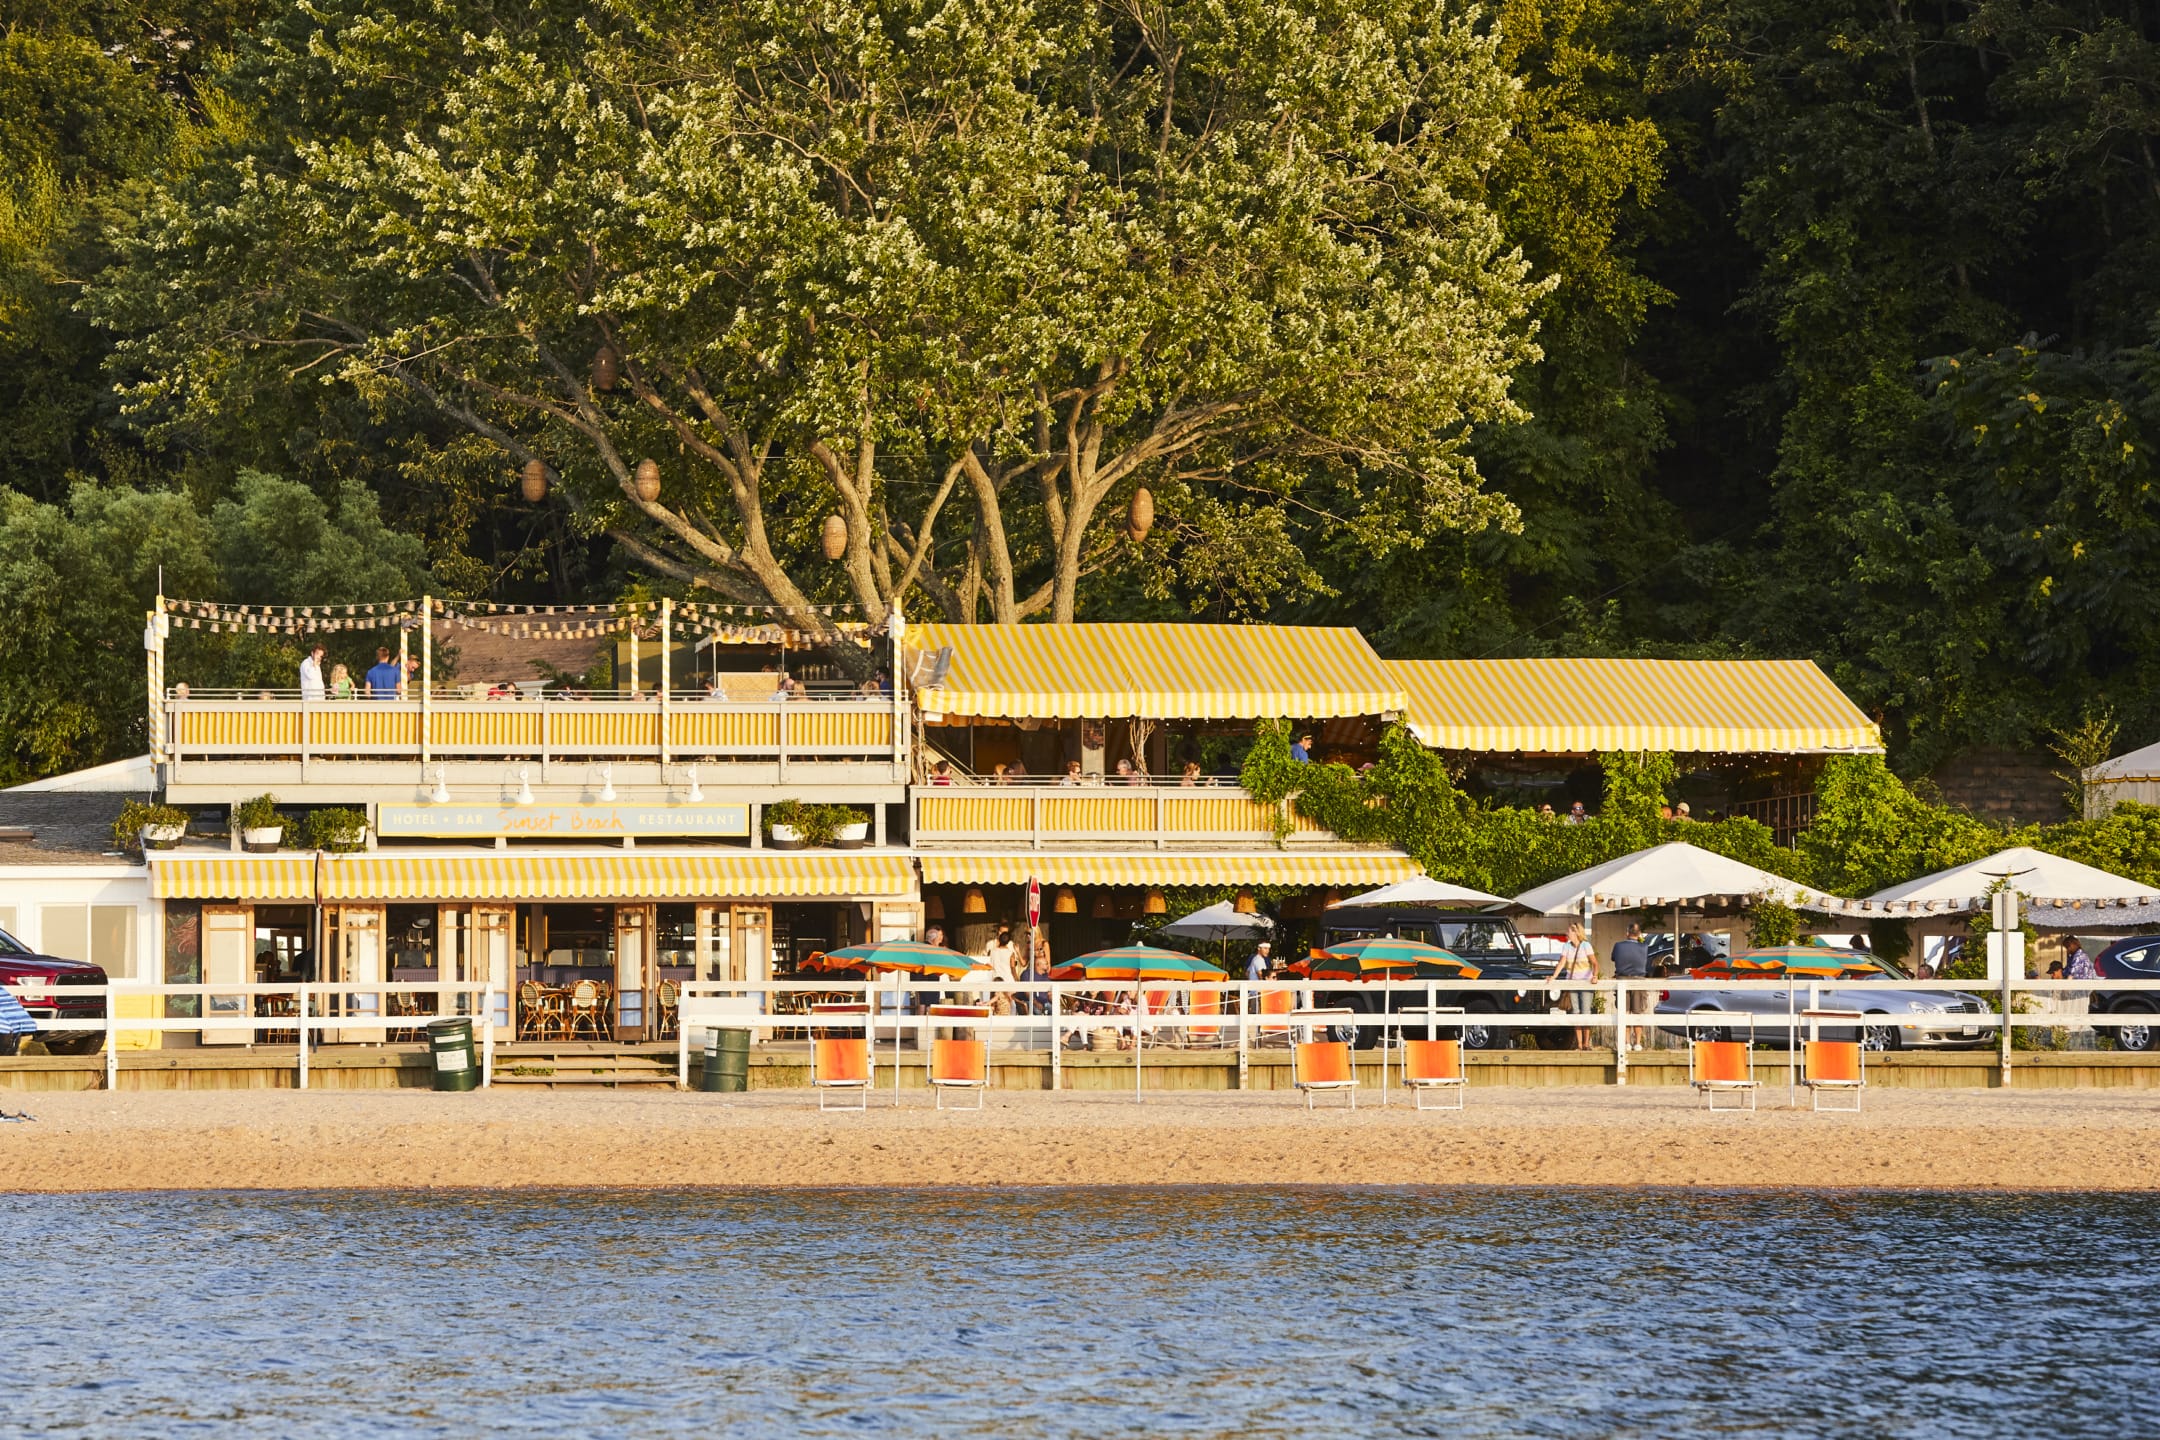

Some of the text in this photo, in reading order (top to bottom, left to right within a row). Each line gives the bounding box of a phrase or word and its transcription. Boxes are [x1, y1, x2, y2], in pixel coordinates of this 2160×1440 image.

[393, 813, 484, 825] HOTEL BAR
[496, 808, 625, 831] Sunset Beach
[639, 813, 737, 825] RESTAURANT
